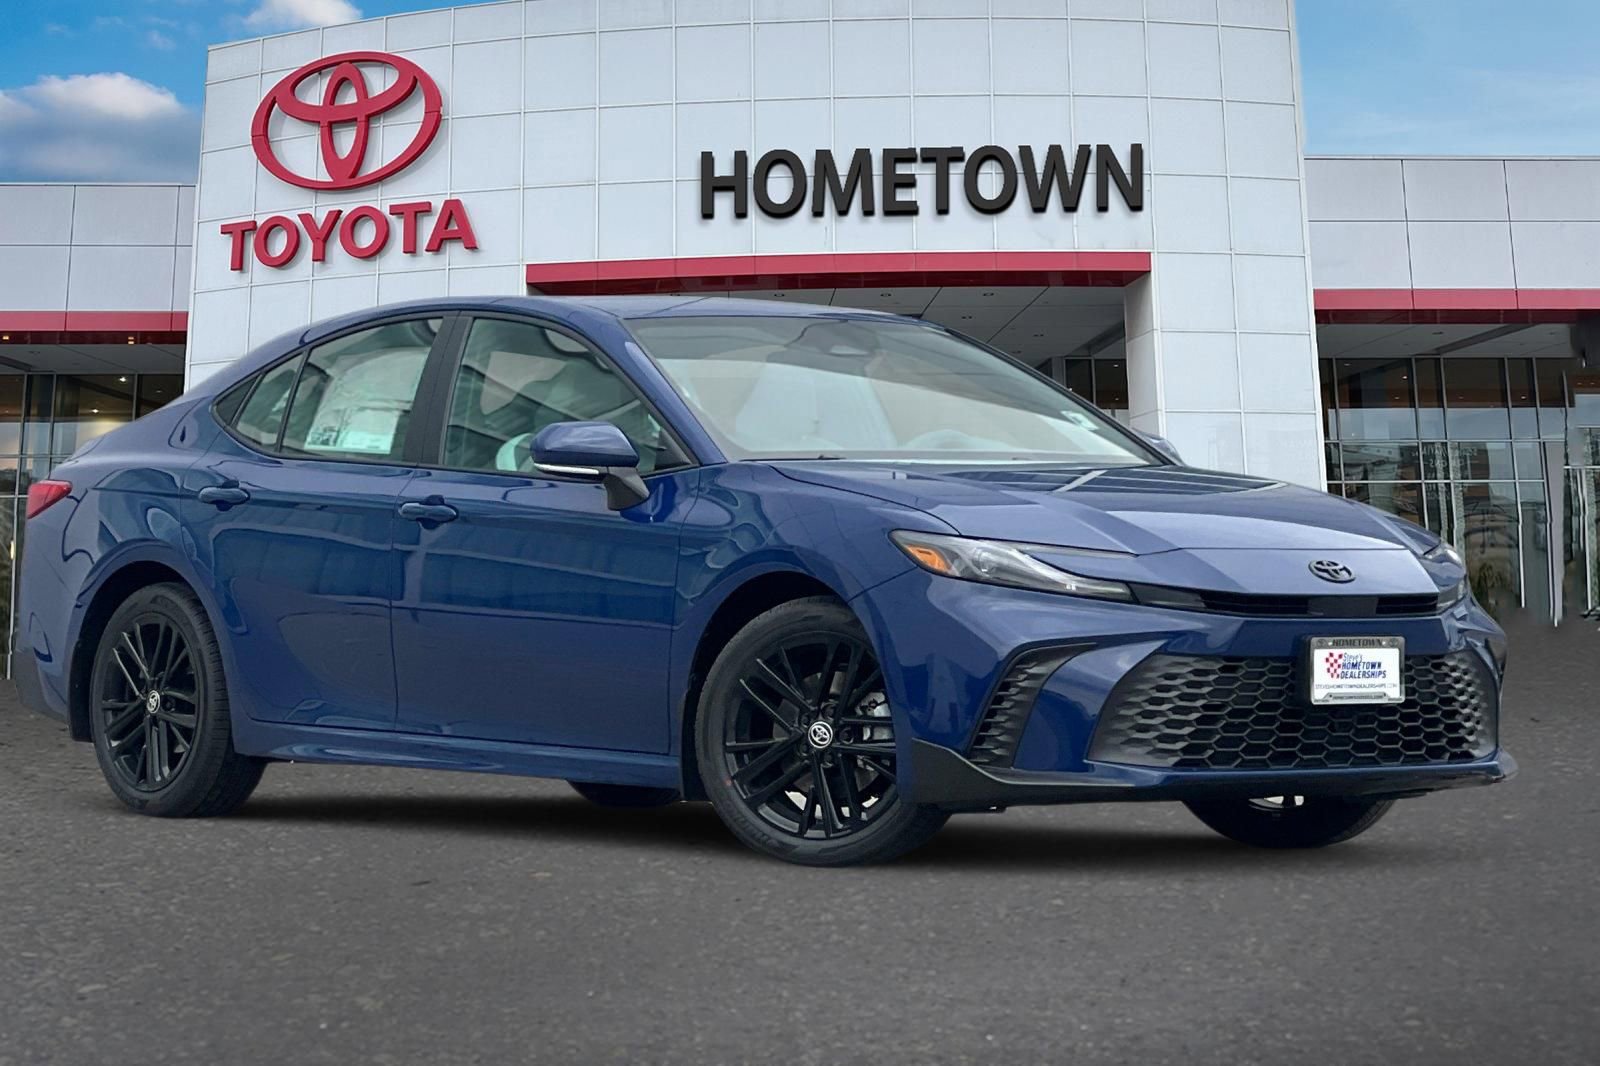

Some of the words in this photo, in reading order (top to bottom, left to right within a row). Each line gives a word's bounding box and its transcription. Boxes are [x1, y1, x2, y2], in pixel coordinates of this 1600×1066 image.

[700, 143, 1144, 219] HOMETOWN
[220, 198, 479, 271] TOYOTA
[1332, 638, 1383, 647] HOMETOWN
[1343, 652, 1363, 662] Steve's
[1341, 661, 1382, 670] HOMETOWN
[1340, 670, 1387, 679] DEALERSHIPS
